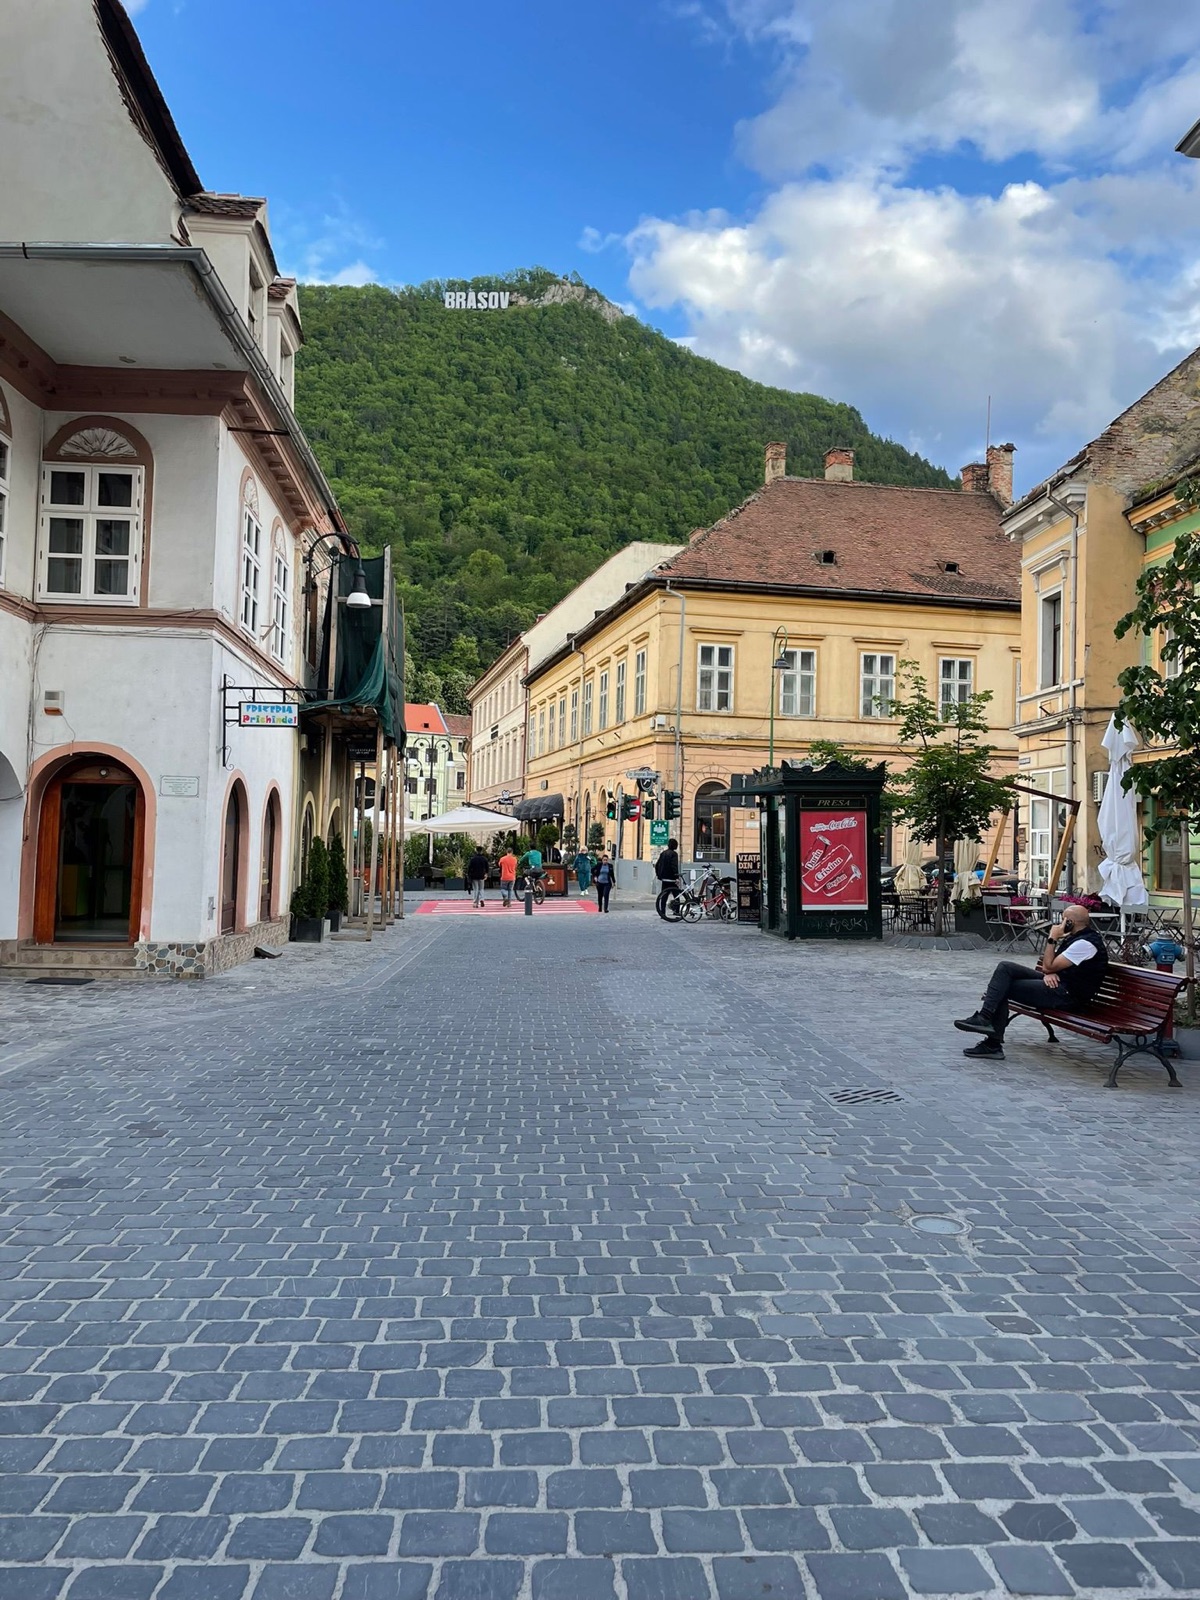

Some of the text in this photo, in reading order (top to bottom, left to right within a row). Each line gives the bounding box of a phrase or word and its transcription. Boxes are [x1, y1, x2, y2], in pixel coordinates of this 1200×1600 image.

[242, 714, 297, 724] Prichindel
[817, 799, 851, 807] PRESA
[816, 858, 843, 881] Cristina
